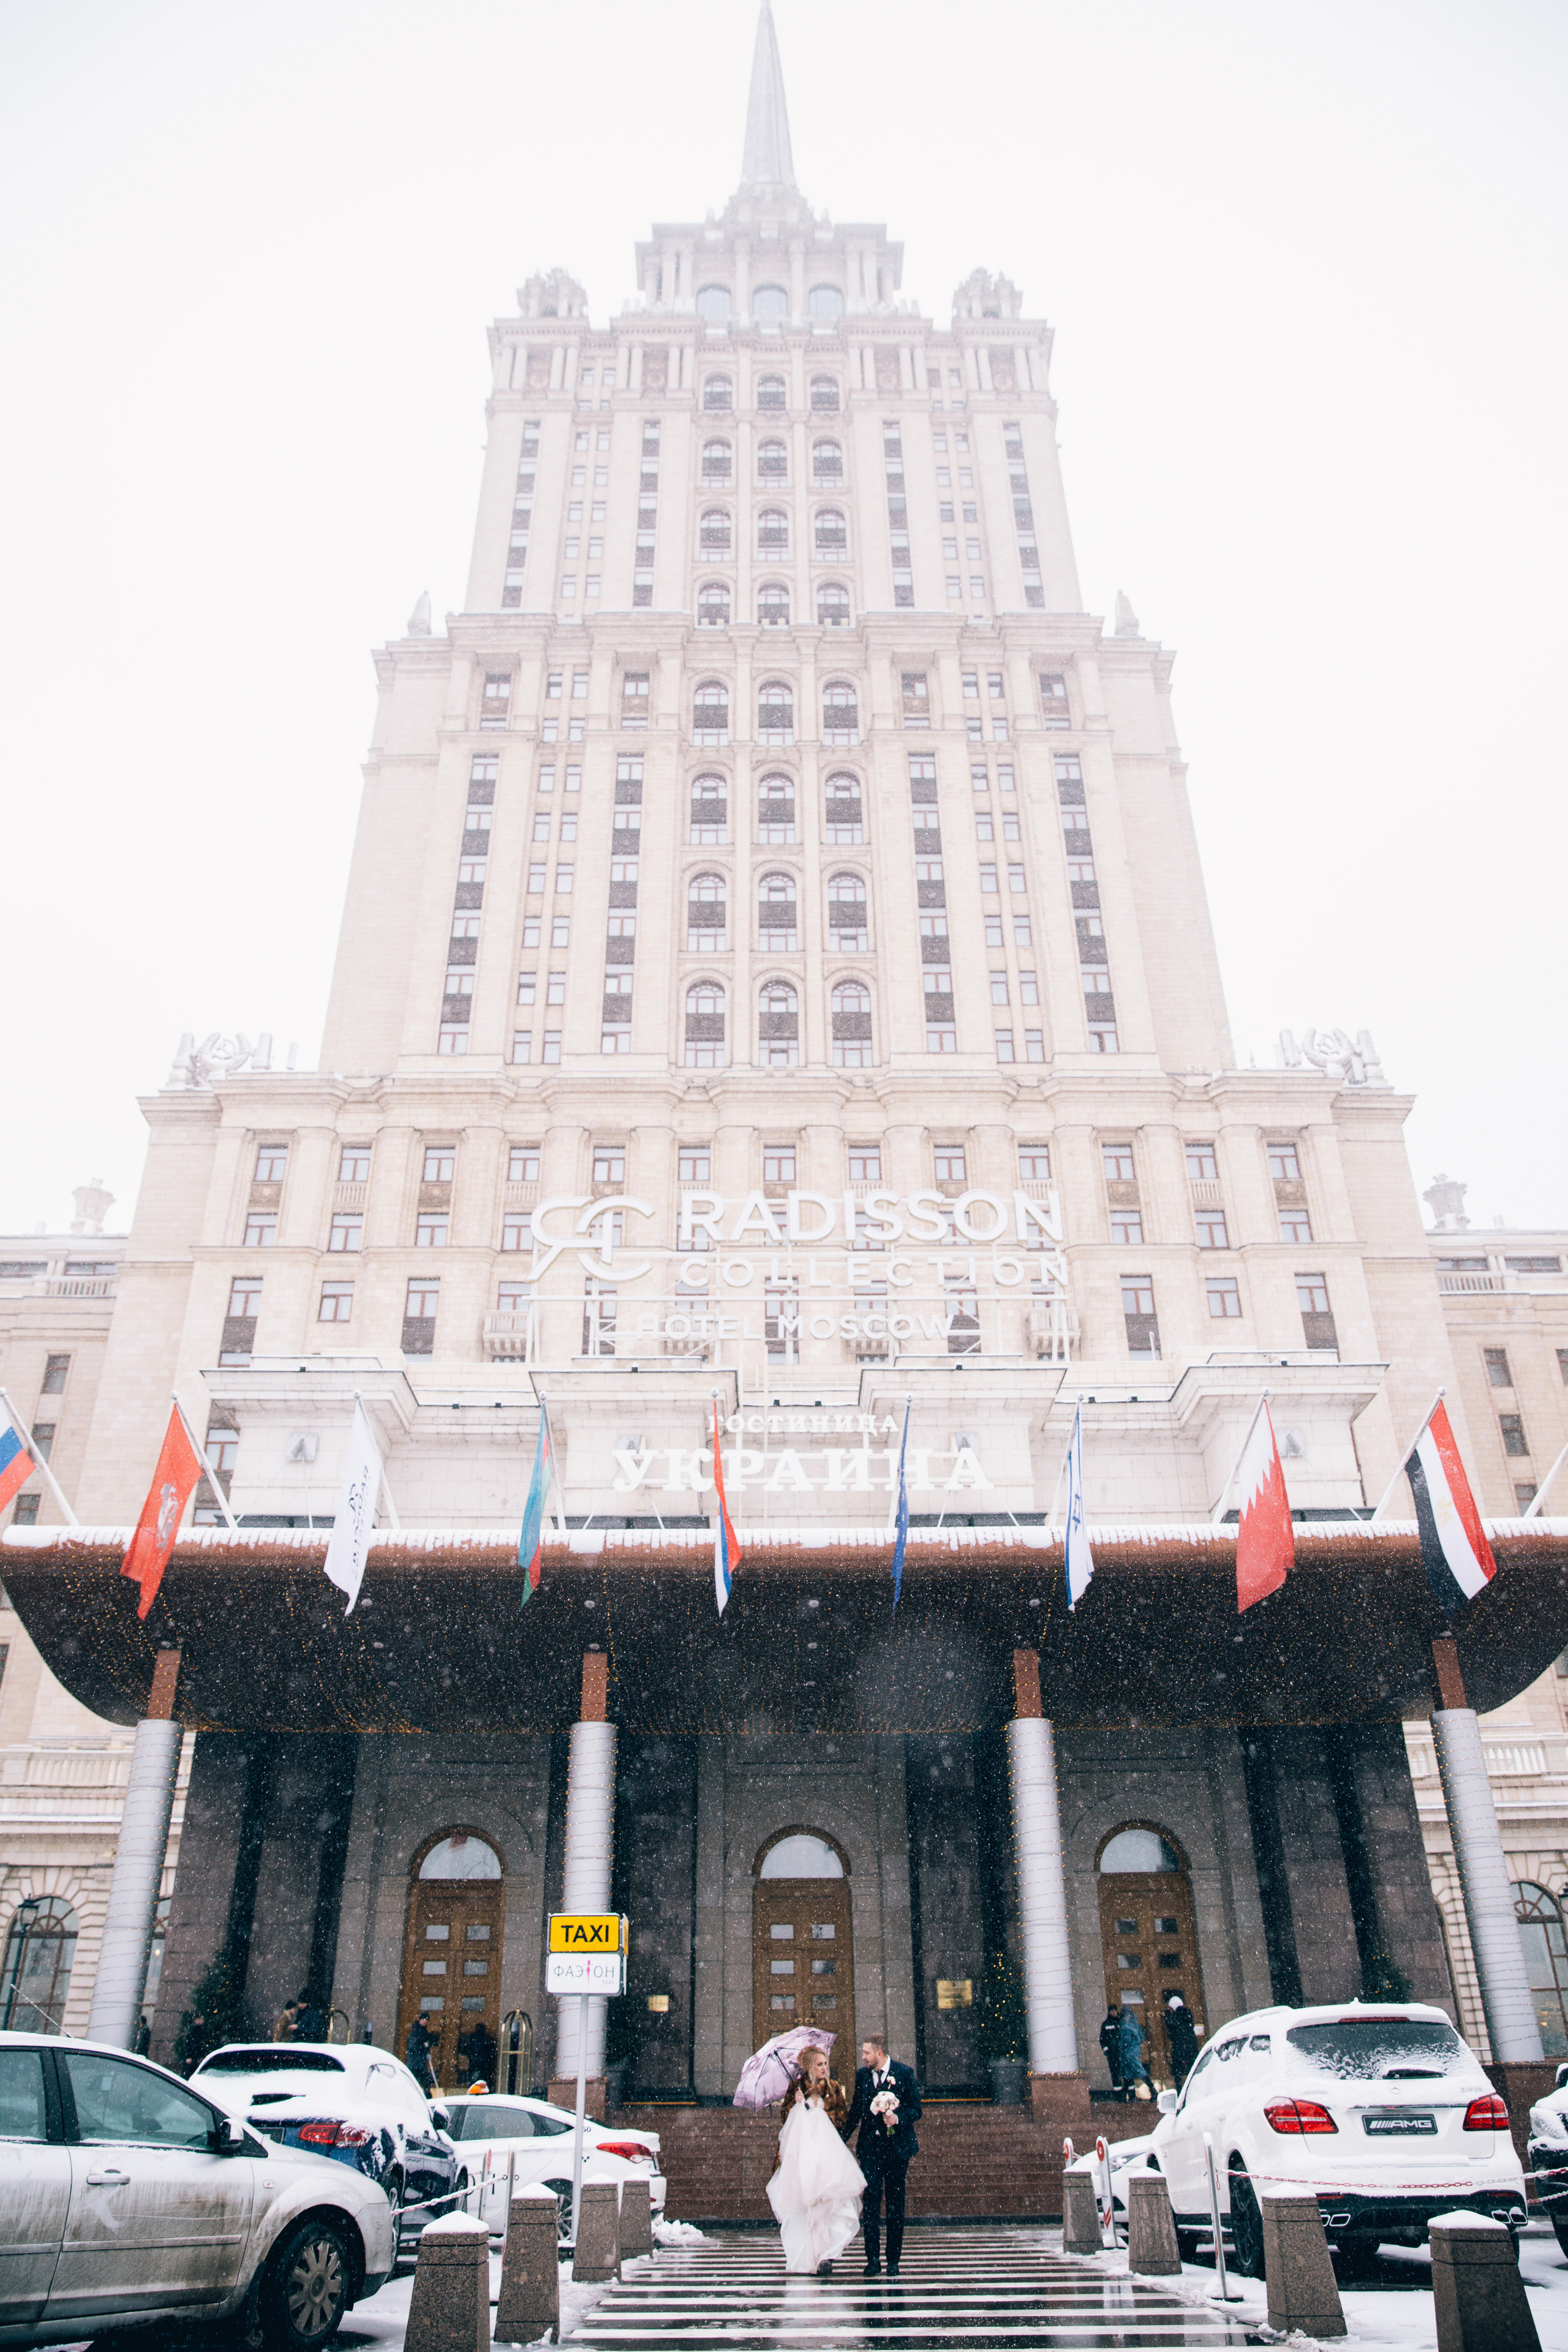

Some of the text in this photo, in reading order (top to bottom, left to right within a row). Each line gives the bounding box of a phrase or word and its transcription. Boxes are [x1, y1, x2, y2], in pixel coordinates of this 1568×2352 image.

[681, 1189, 1063, 1243] RADISSON
[680, 1257, 1068, 1287] COLLECTION
[637, 1314, 954, 1340] HOTEL MOSCOW
[707, 1414, 899, 1437] ГОСТИНИЦА
[611, 1447, 995, 1492] УКРАИНА
[561, 1925, 609, 1942] TAXI
